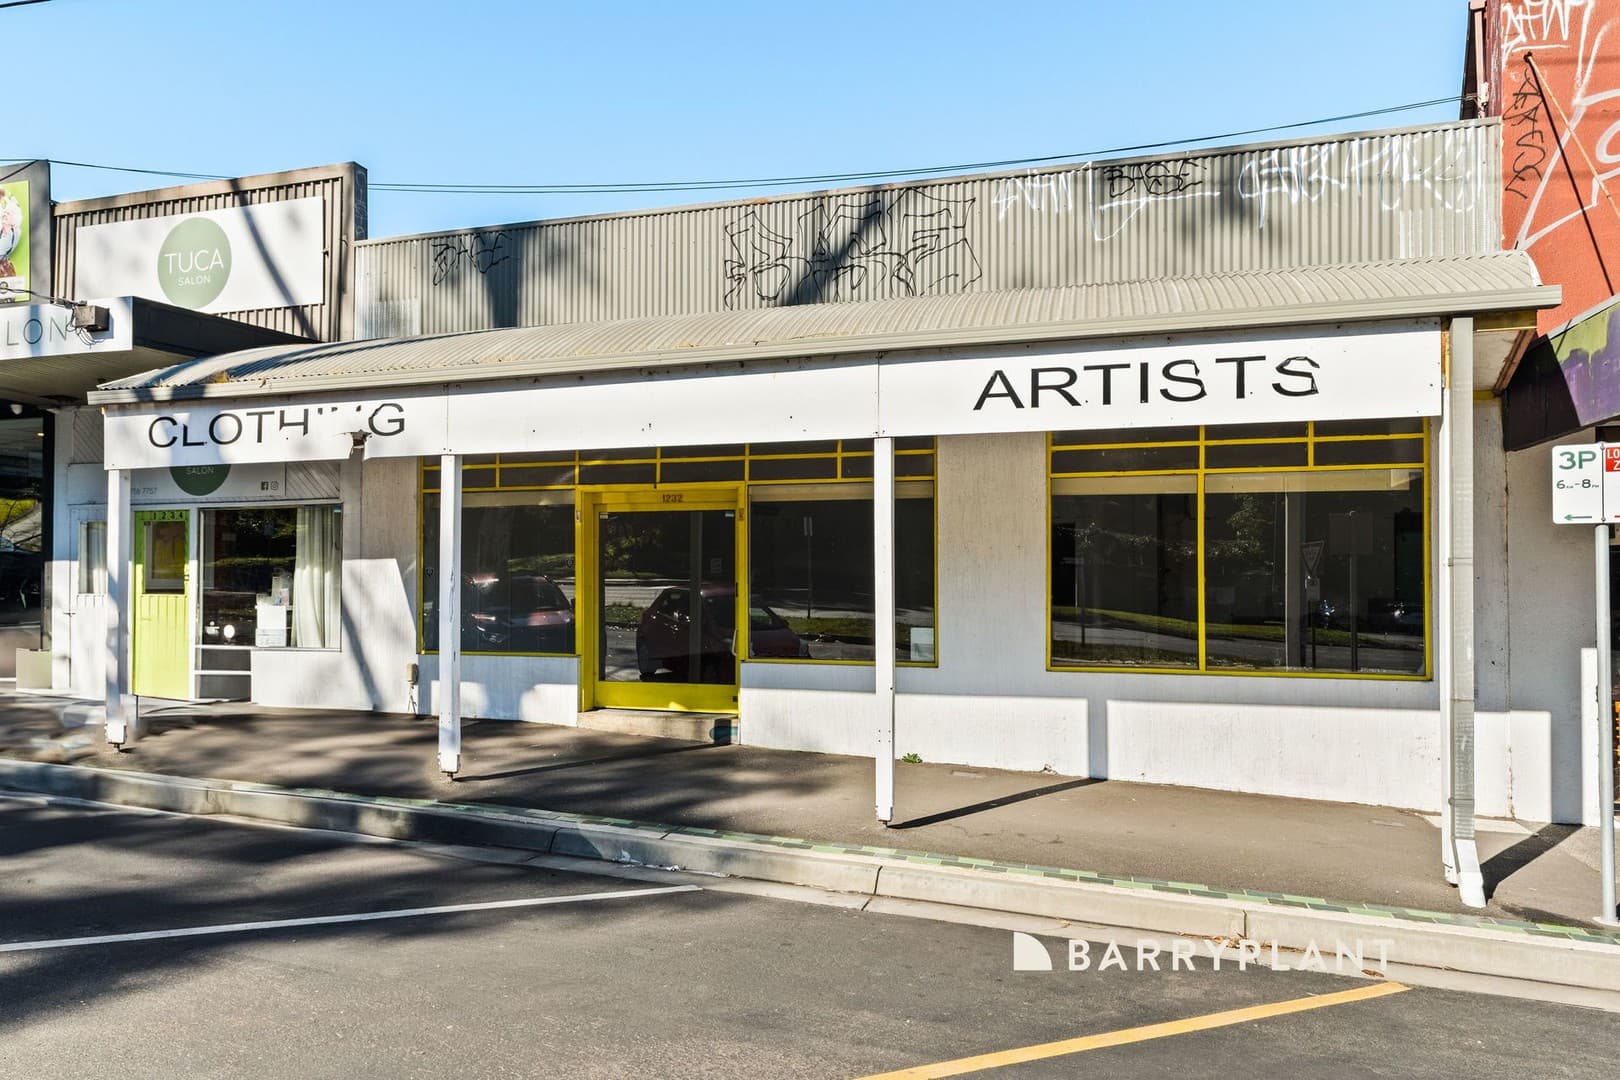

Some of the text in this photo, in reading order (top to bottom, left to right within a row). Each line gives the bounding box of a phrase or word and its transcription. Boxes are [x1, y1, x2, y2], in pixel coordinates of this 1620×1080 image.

[1103, 158, 1207, 199] BASE
[164, 248, 225, 275] TUCA
[177, 274, 211, 288] SALON
[973, 354, 1321, 411] ARTISTS
[148, 402, 406, 449] CLOTHG
[186, 466, 214, 475] SALON
[1559, 451, 1597, 469] 3P
